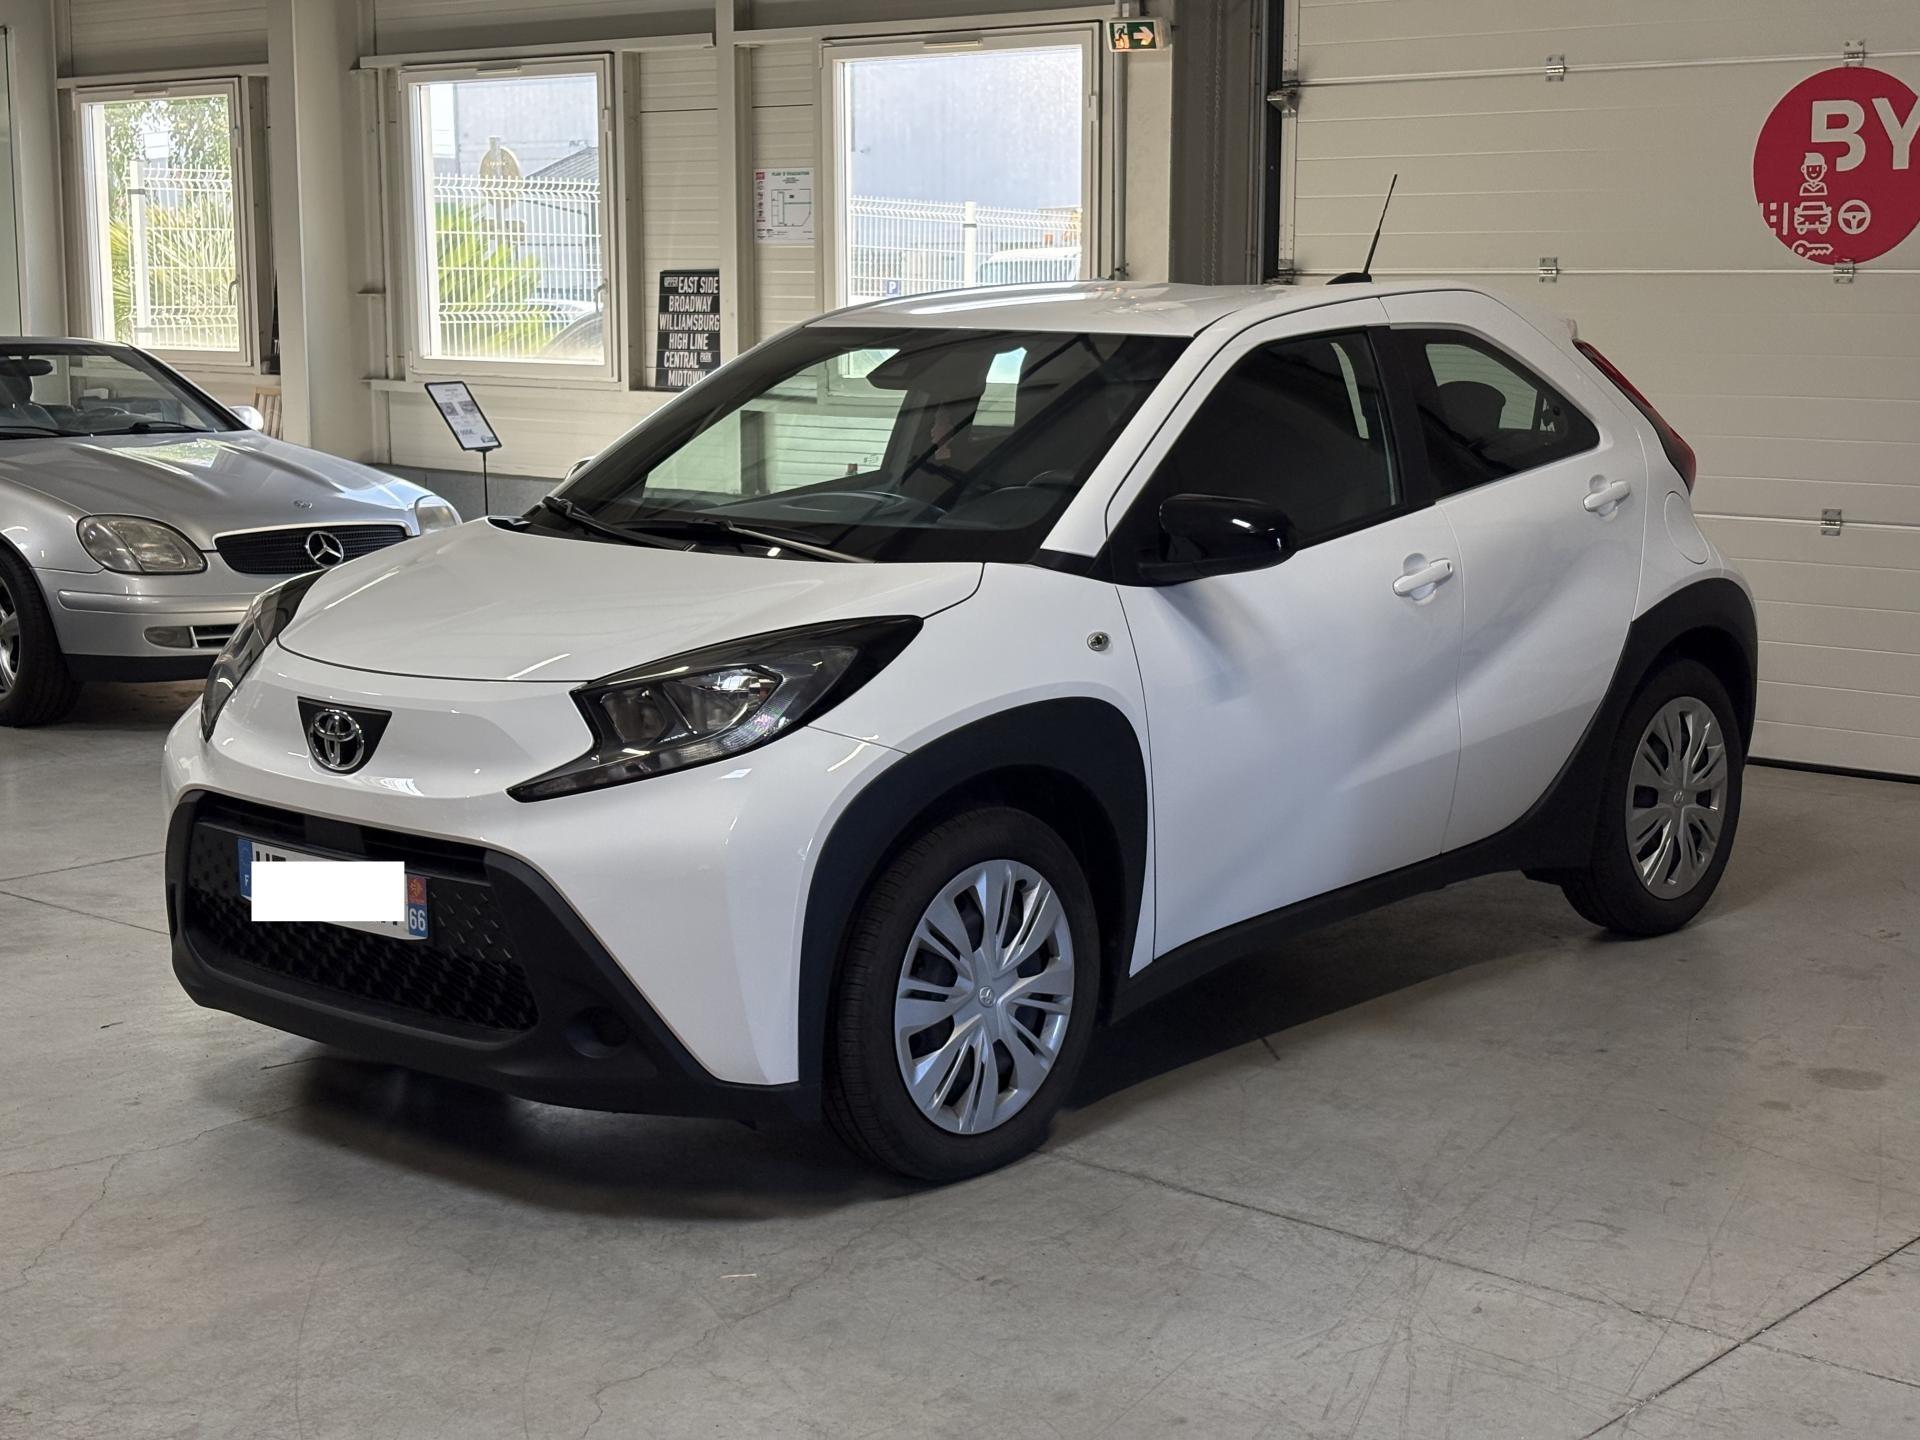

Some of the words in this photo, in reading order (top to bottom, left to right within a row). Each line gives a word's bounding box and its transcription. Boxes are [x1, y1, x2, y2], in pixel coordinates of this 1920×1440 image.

[1811, 97, 1920, 172] BY
[678, 276, 699, 293] EAST
[699, 276, 719, 293] SIDE
[668, 295, 712, 312] BROADWAY
[659, 314, 720, 331] WILLIAMSBURG
[668, 333, 688, 349] HIGH
[690, 333, 709, 350] LINE
[663, 351, 699, 368] CENTRAL
[700, 352, 712, 362] PARK
[244, 874, 249, 887] F
[409, 908, 426, 931] 66
